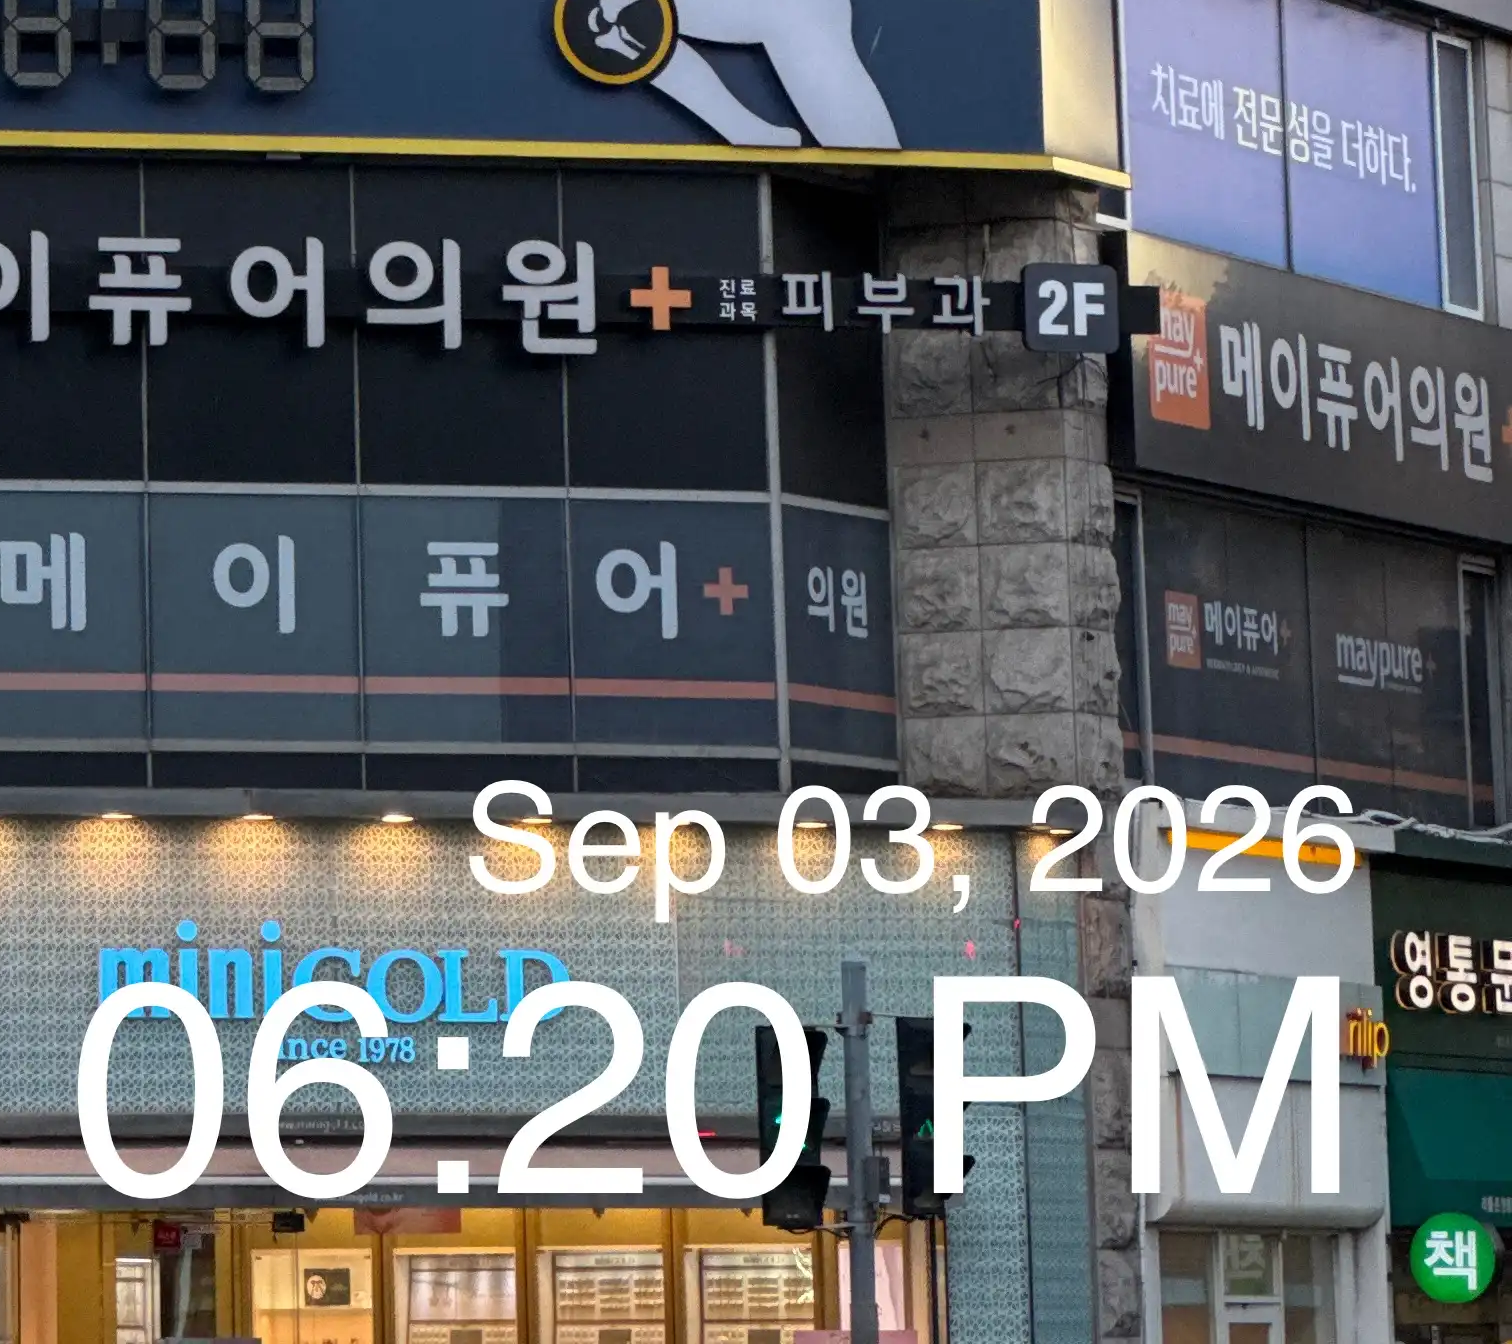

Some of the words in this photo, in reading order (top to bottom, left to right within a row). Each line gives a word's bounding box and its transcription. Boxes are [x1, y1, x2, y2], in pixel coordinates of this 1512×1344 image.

[1149, 62, 1226, 142] 치료에
[1232, 85, 1336, 172] 전문성을
[780, 271, 992, 338] 피부과
[1037, 279, 1107, 338] 2F
[1153, 356, 1199, 402] pure
[1218, 321, 1495, 484] 메이퓨어의원
[806, 564, 871, 641] 의원
[1202, 599, 1280, 657] 메이퓨어
[1336, 632, 1424, 689] maypure
[1423, 1230, 1478, 1292] 책
